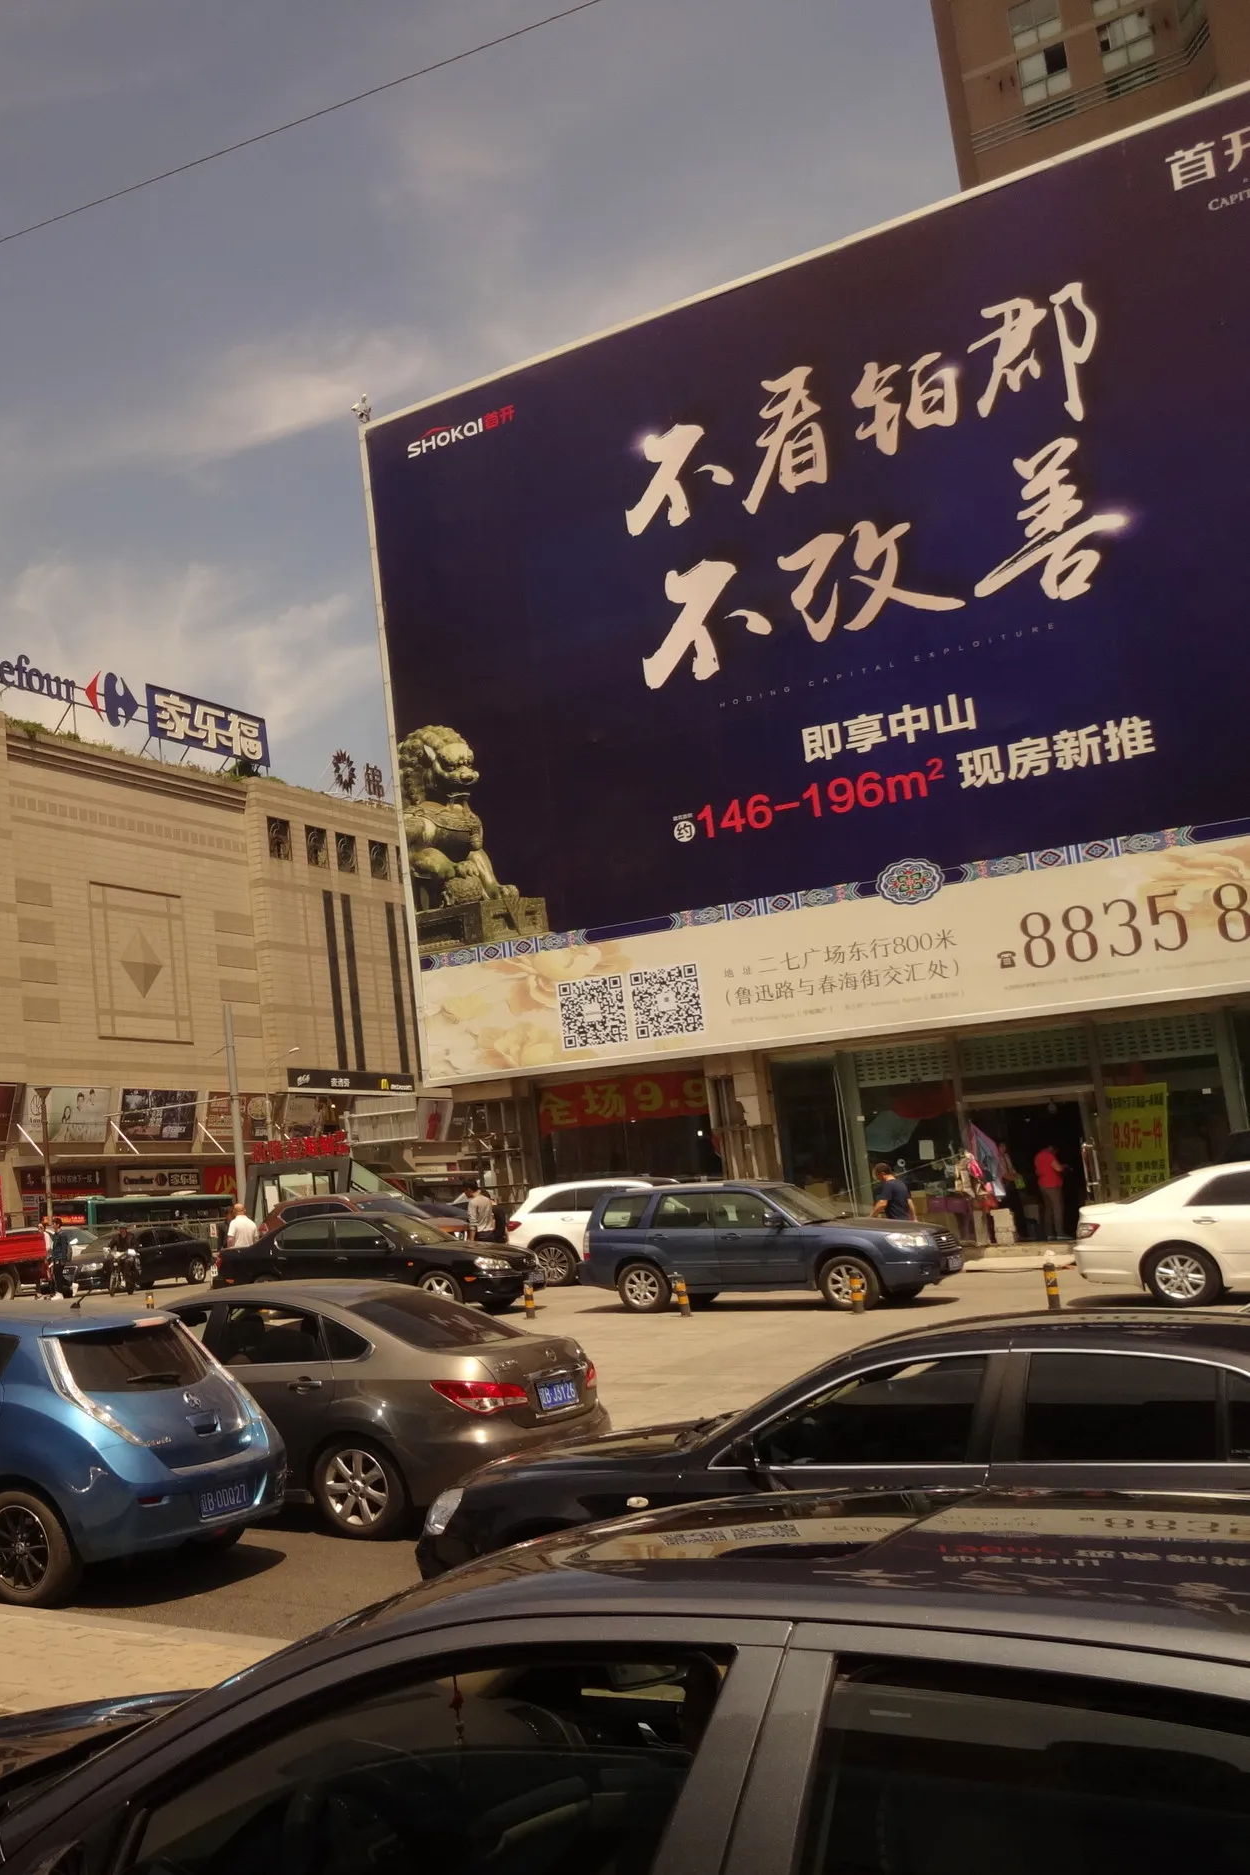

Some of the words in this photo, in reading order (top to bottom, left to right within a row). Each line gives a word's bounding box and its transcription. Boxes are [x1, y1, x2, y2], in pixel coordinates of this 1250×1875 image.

[483, 403, 515, 430] 首开
[642, 436, 1127, 690] 不改善
[808, 661, 896, 688] CAPITAL
[155, 692, 264, 762] 家乐福
[801, 694, 978, 764] 即享中山
[956, 715, 1156, 791] 现房新推
[675, 822, 694, 841] 约
[758, 928, 958, 974] 二七广场东行800米
[1019, 889, 1189, 969] 8835
